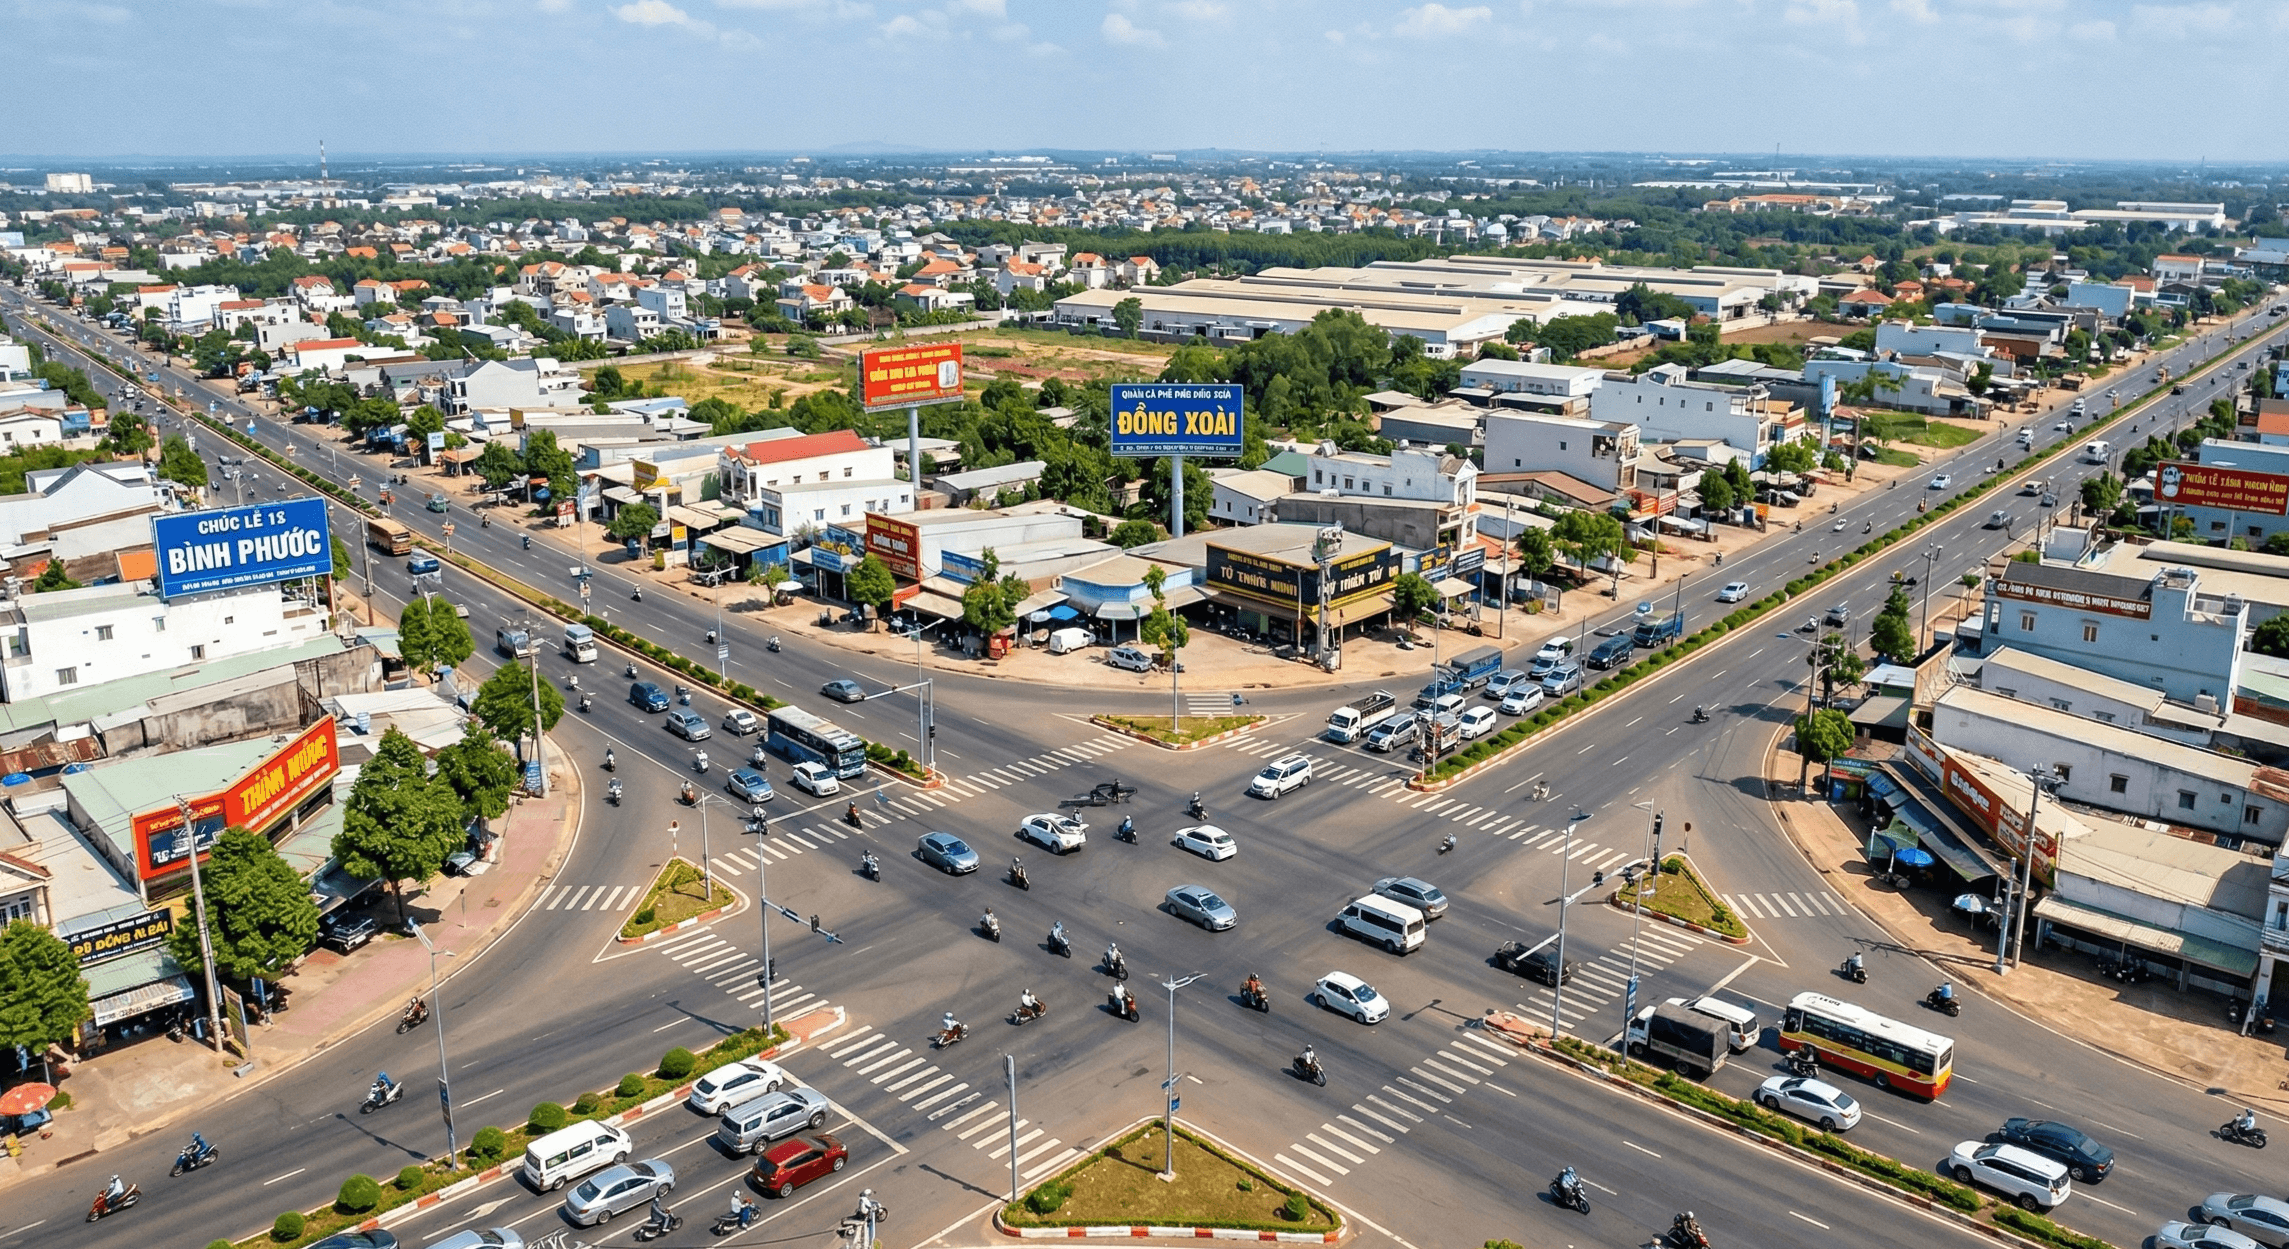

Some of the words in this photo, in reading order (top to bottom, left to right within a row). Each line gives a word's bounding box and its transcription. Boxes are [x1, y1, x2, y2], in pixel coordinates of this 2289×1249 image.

[1117, 402, 1178, 435] ĐỒNG
[1184, 404, 1236, 435] XOÀI
[198, 514, 240, 535] CHÚC
[268, 510, 287, 526] 18
[168, 541, 232, 575] BÌNH
[237, 526, 322, 565] PHƯỚC
